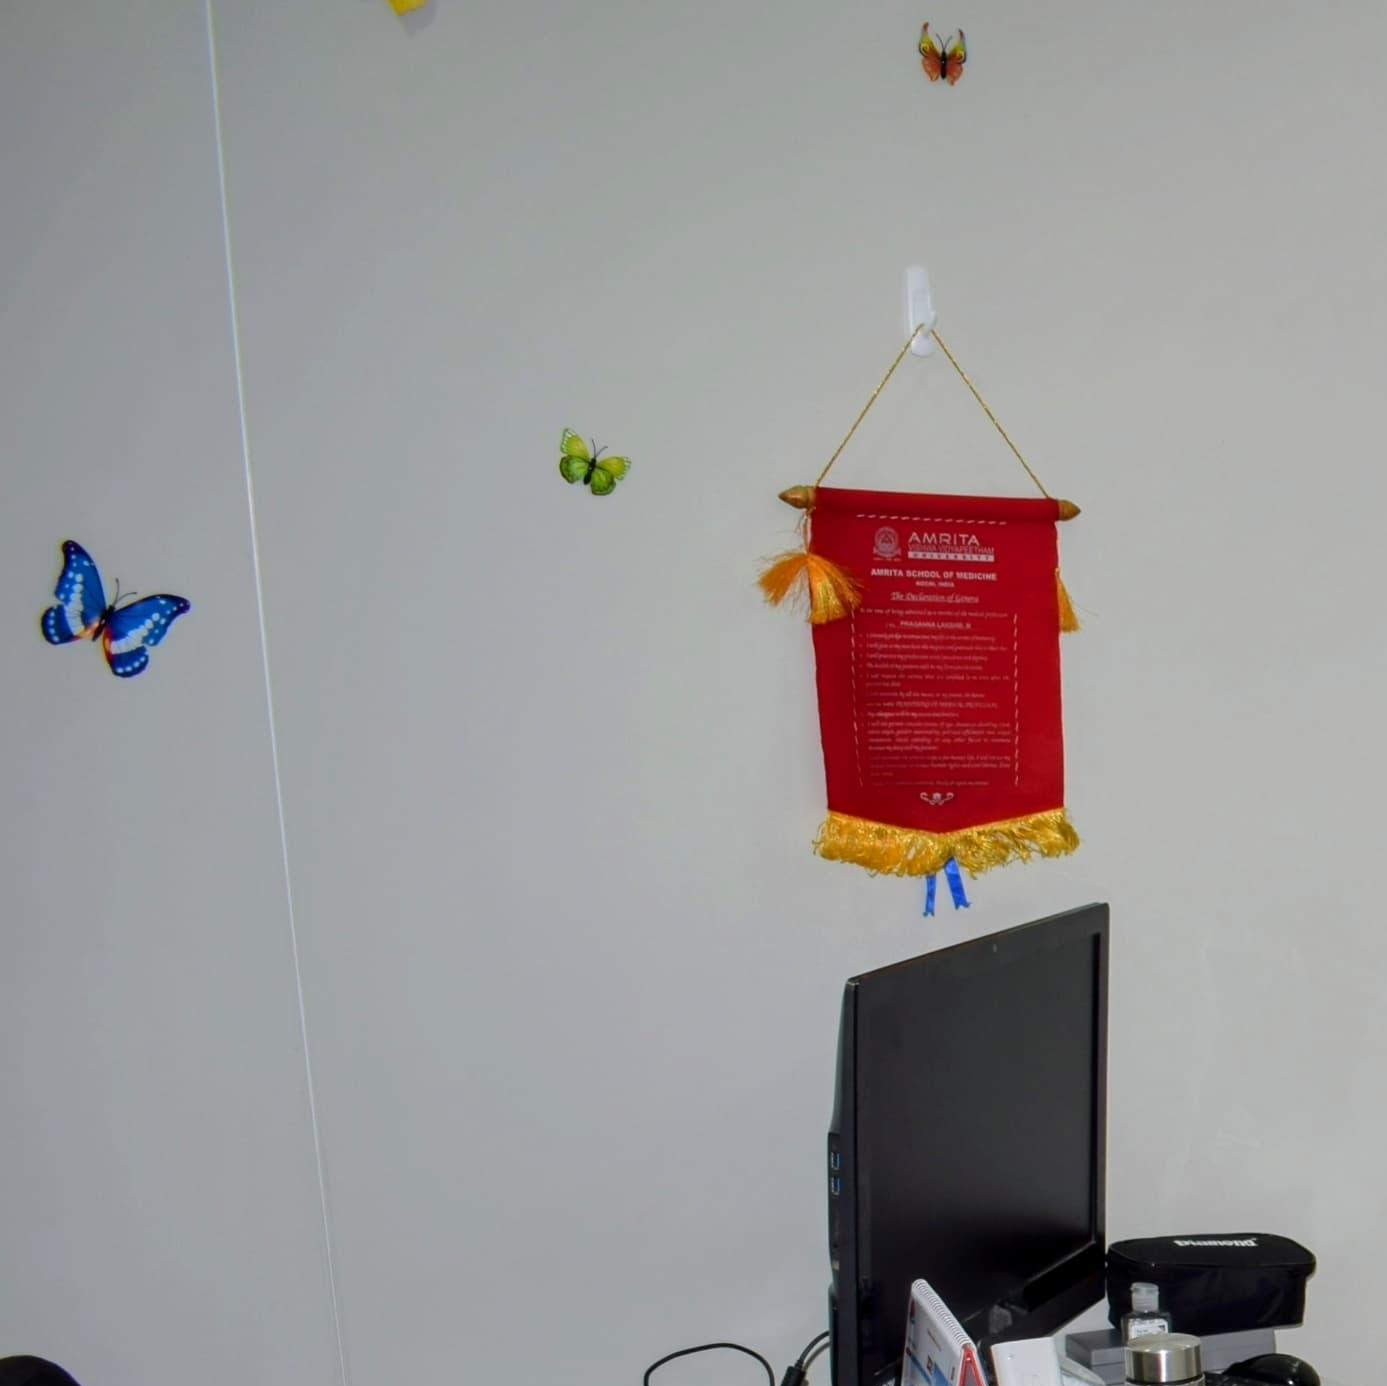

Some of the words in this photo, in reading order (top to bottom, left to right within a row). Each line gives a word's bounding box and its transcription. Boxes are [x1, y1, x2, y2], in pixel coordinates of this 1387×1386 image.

[908, 531, 980, 546] AMRITA
[870, 567, 904, 577] AMRITA
[906, 569, 940, 579] SCHOOL
[943, 571, 955, 579] OF
[956, 571, 998, 582] MEDICINE
